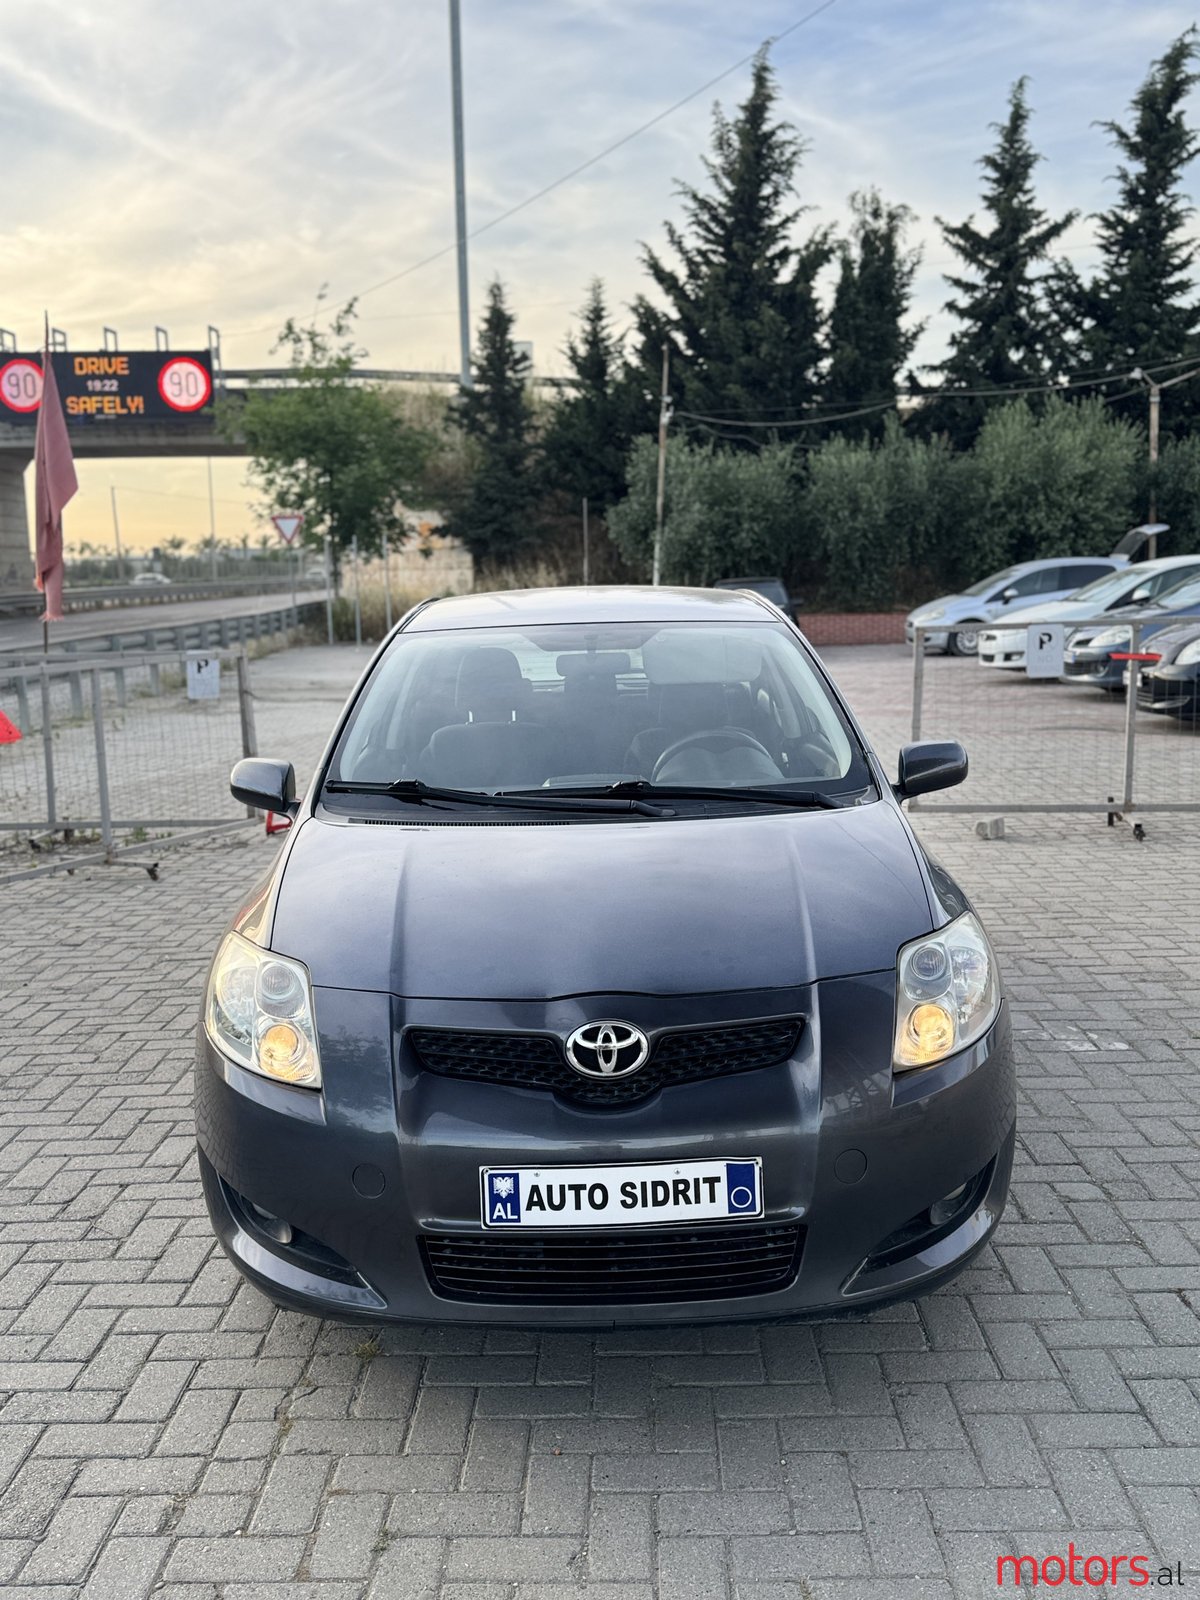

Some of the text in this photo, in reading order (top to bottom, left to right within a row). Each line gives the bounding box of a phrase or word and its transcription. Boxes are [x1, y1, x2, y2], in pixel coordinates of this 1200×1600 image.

[74, 356, 130, 376] DRIVE
[7, 372, 37, 399] 90
[169, 371, 199, 398] 90
[66, 395, 145, 414] SAFELY!
[525, 1176, 721, 1212] AUTO SIDRIT
[492, 1202, 518, 1220] AL
